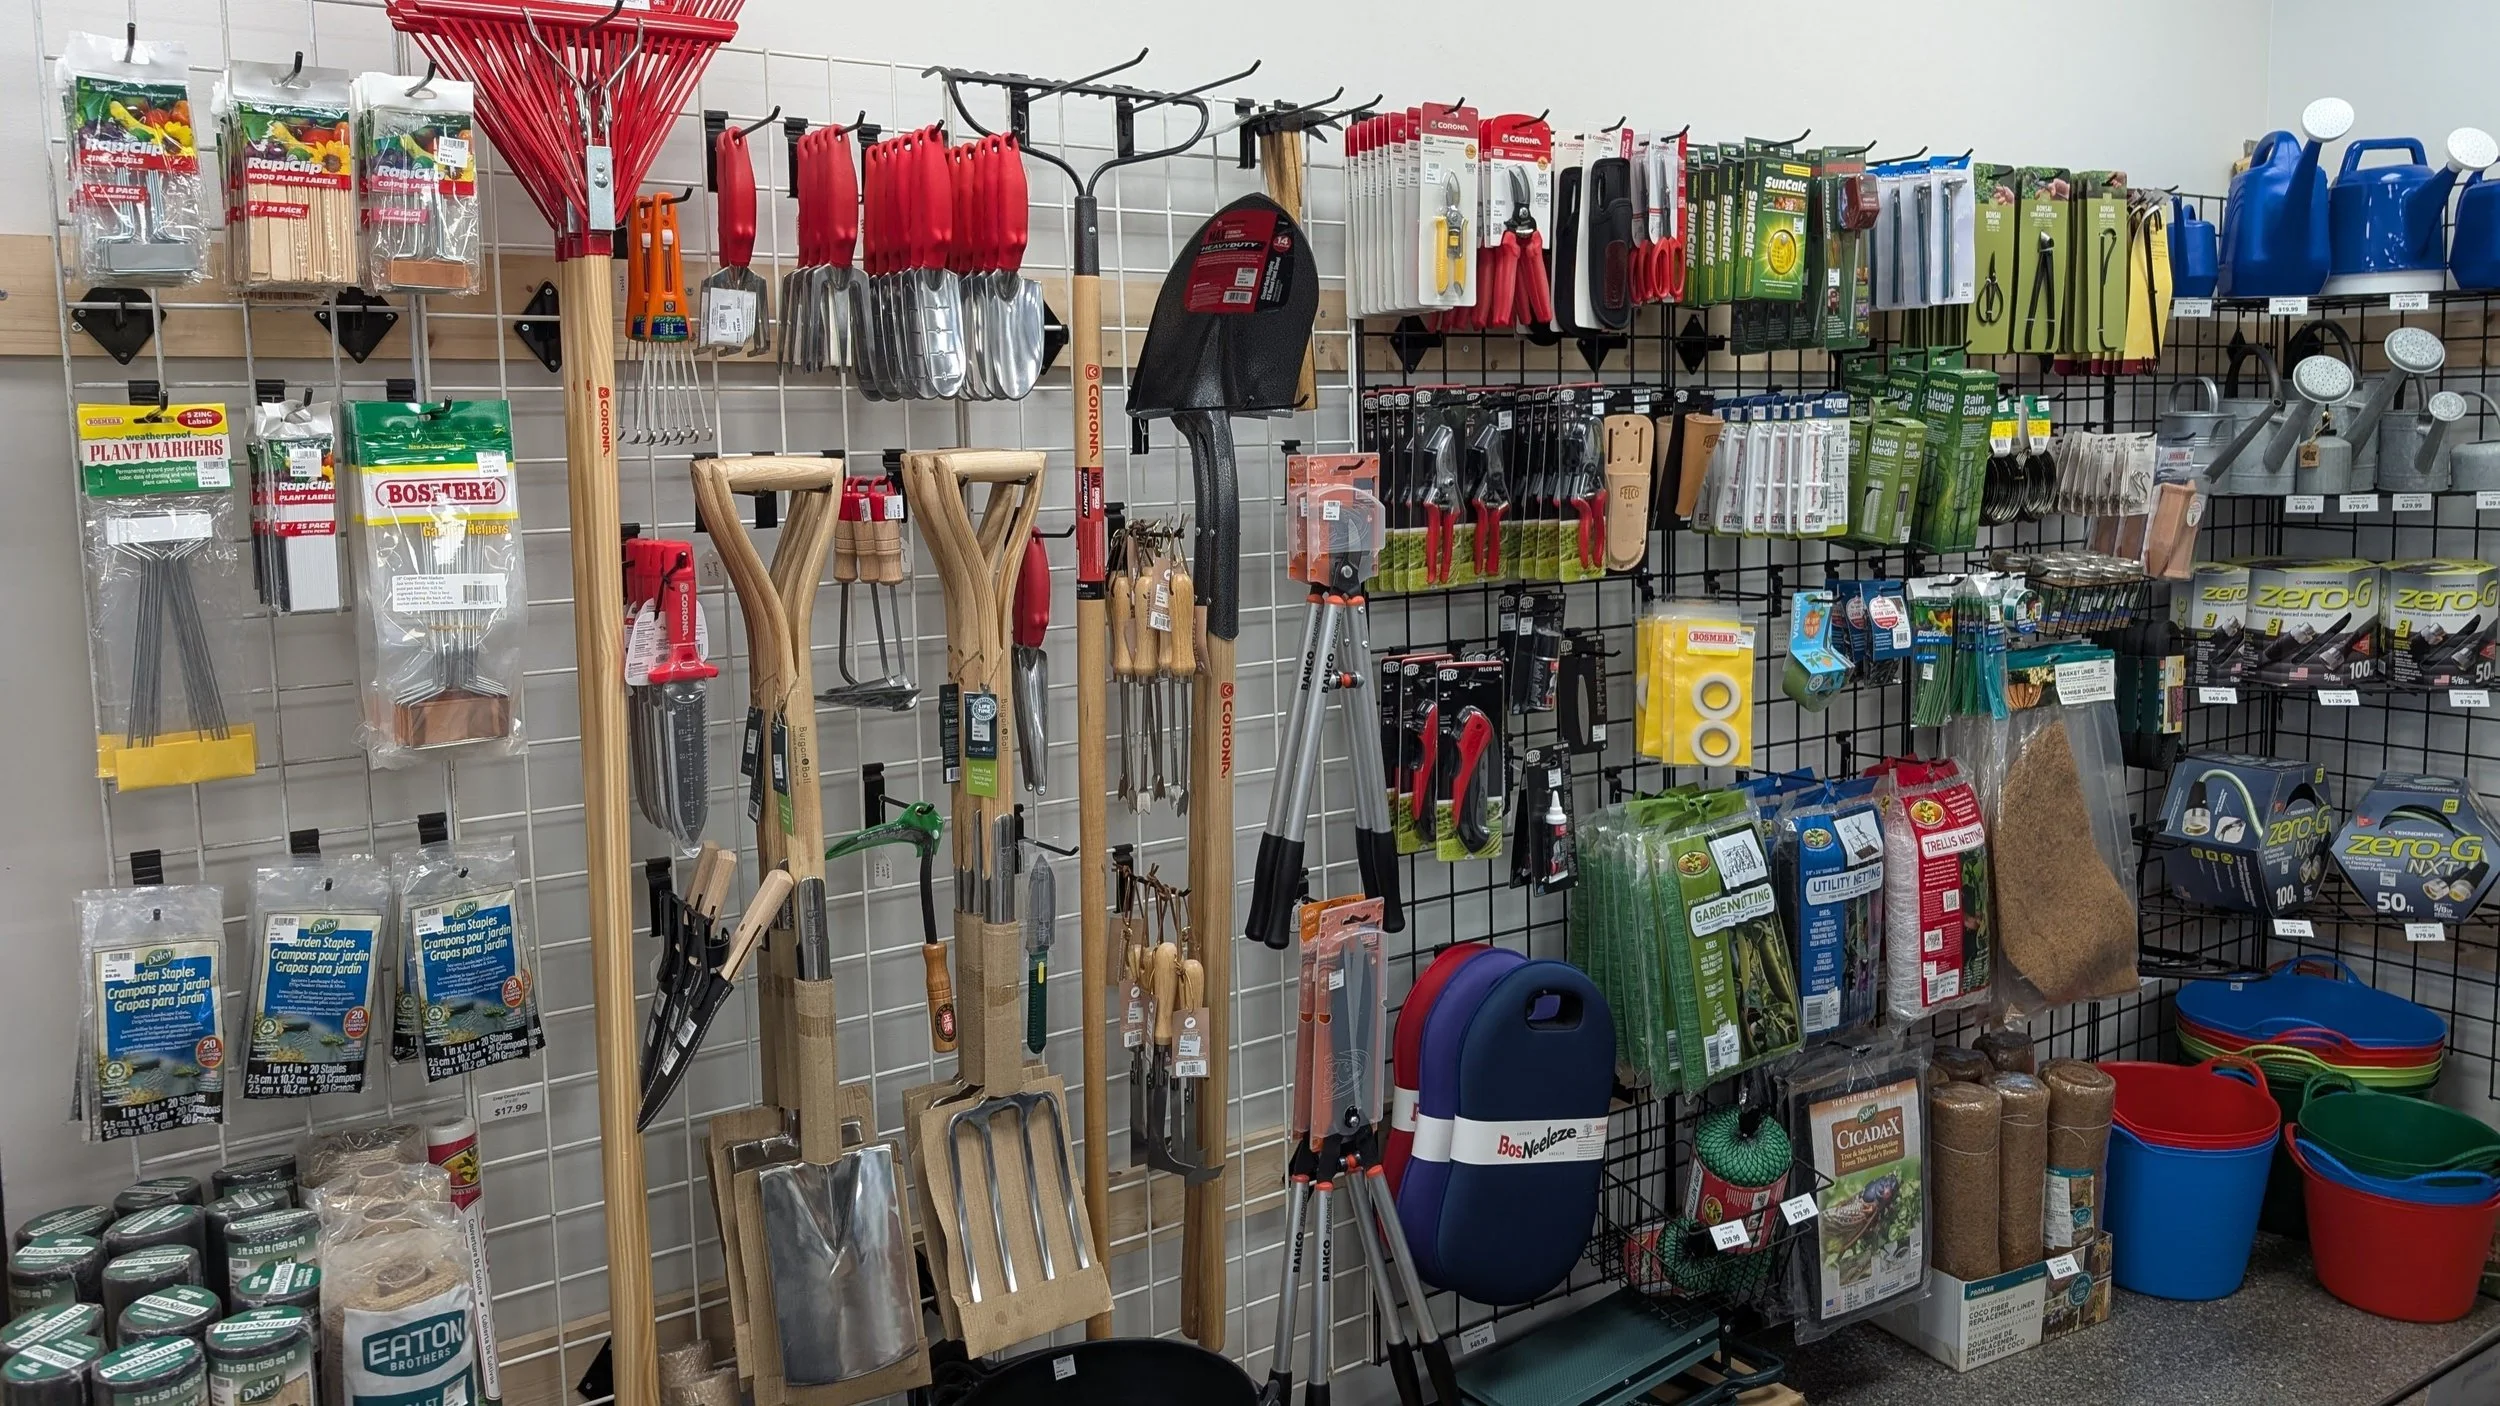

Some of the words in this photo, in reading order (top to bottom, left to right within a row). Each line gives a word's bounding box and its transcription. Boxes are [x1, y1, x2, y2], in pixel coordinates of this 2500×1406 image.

[1438, 121, 1469, 132] CORONA
[85, 138, 163, 157] RapiClip
[1509, 135, 1541, 146] CORONA
[111, 155, 144, 165] LABELS
[247, 158, 323, 175] RapiClip
[249, 172, 271, 181] WOOD
[276, 175, 303, 183] PLANT
[305, 176, 338, 186] LABELS
[377, 166, 445, 181] RapiClip
[115, 187, 141, 196] PACK
[378, 181, 407, 189] COPPER
[1764, 176, 1807, 193] SunCalc
[279, 206, 303, 216] PACK
[1722, 194, 1733, 262] SunCalc
[1745, 190, 1758, 260] SunCalc
[1276, 236, 1289, 245] 14
[1686, 202, 1697, 269] SunCalc
[1706, 200, 1716, 267] SunCalc
[1201, 242, 1258, 252] HEAVYDUTY
[2184, 308, 2201, 316] $9.99
[1889, 378, 1917, 390] rapitest
[1929, 379, 1959, 391] rapitest
[1965, 381, 1995, 392] rapitest
[1379, 394, 1394, 405] FELCO
[1394, 393, 1410, 405] FELCO
[1416, 391, 1432, 403] FELCO
[1560, 390, 1575, 401] FELCO
[1928, 388, 1955, 404] Lluvia
[1963, 394, 1985, 405] Rain
[1824, 398, 1849, 409] EZVIEW
[1926, 400, 1953, 414] Medir
[1962, 405, 1992, 416] Gauge
[600, 399, 610, 458] CORONA
[1088, 384, 1099, 460] CORONA
[126, 431, 192, 441] weatherproof
[1872, 437, 1898, 449] Lluvia
[90, 443, 142, 463] PLANT
[147, 439, 223, 460] MARKERS
[1871, 446, 1897, 457] Medir
[1905, 441, 1918, 450] Rain
[1903, 450, 1921, 460] Gauge
[278, 480, 335, 492] RapiClip
[387, 481, 496, 504] BOSMERE
[1620, 486, 1640, 499] FELCO
[1804, 515, 1823, 524] EZVIEW
[467, 524, 509, 536] Helpers
[1499, 595, 1515, 608] FELCO
[2255, 577, 2373, 611] zero-G
[2394, 579, 2498, 612] zero-G
[1520, 596, 1534, 609] FELCO
[681, 593, 689, 637] CORONA
[1792, 596, 1802, 639] VELCRO
[2269, 618, 2277, 628] 5
[2399, 620, 2407, 630] 5
[1693, 633, 1734, 643] BOSMERE
[1301, 650, 1314, 692] BAHCO
[1322, 653, 1335, 695] BAHCO
[1383, 661, 1400, 674] FELCO
[1404, 663, 1420, 676] FELCO
[1440, 669, 1459, 681] FELCO
[2349, 659, 2370, 680] 100
[2475, 661, 2492, 683] 50
[1221, 700, 1232, 776] CORONA
[1526, 750, 1541, 763] FELCO
[2266, 804, 2331, 848] zero-G
[1925, 836, 1958, 853] TRELLIS
[1958, 828, 1984, 845] NETTING
[2394, 830, 2421, 838] TEKNOR
[2294, 833, 2318, 860] NXT
[2345, 833, 2484, 863] zero-G
[2407, 859, 2460, 878] NXT
[1813, 877, 1850, 893] UTILITY
[1853, 865, 1881, 884] NETTING
[2275, 885, 2294, 907] 100
[2377, 891, 2406, 912] 50
[467, 915, 498, 931] Staples
[423, 936, 465, 951] Crampons
[466, 931, 485, 946] pour
[486, 924, 512, 941] jardin
[2281, 928, 2306, 936] $129.99
[322, 936, 356, 949] Staples
[271, 948, 317, 962] Crampons
[318, 950, 339, 963] pour
[340, 949, 370, 964] jardin
[430, 948, 461, 962] Grapas
[462, 944, 482, 957] para
[162, 966, 196, 981] Staples
[275, 961, 309, 975] Grapas
[309, 963, 333, 976] para
[107, 983, 157, 1001] Crampons
[158, 982, 180, 995] pour
[181, 977, 211, 991] jardin
[507, 980, 518, 989] 20
[114, 996, 150, 1013] Grapas
[151, 994, 175, 1008] para
[351, 1010, 364, 1020] 20
[202, 1040, 217, 1050] 20
[481, 1037, 490, 1047] 20
[489, 1031, 513, 1046] Staples
[439, 1055, 450, 1066] cm
[457, 1051, 471, 1063] 10.2
[471, 1050, 482, 1060] cm
[496, 1038, 528, 1053] Crampons
[309, 1064, 320, 1074] 20
[321, 1063, 347, 1075] Staples
[247, 1073, 261, 1084] 2.5
[262, 1076, 273, 1084] cm
[280, 1074, 295, 1085] 10.2
[296, 1076, 308, 1085] cm
[315, 1075, 326, 1085] 20
[326, 1073, 362, 1085] Crampons
[167, 1098, 179, 1110] 20
[179, 1092, 206, 1108] Staples
[116, 1118, 130, 1129] cm
[155, 1111, 168, 1123] cm
[188, 1103, 222, 1117] Crampons
[494, 1102, 528, 1117] $17.99
[1836, 1116, 1901, 1150] CICADA-X
[1497, 1126, 1577, 1160] BosNeeleze
[1873, 1140, 1899, 1152] Protection
[1793, 1207, 1810, 1219] $79.99
[1722, 1234, 1741, 1245] $39.99
[1292, 1231, 1304, 1273] BAHCO
[1322, 1239, 1331, 1282] BAHCO
[468, 1218, 479, 1258] Couverture
[475, 1269, 483, 1296] Culture
[481, 1314, 490, 1344] Cubierta
[1968, 1309, 1989, 1319] COCO
[1990, 1302, 2010, 1313] FIBER
[1968, 1306, 2016, 1327] REPLACEMENT
[2016, 1300, 2036, 1311] LINER
[369, 1318, 462, 1367] EATON
[1470, 1336, 1489, 1349] $49.99
[1967, 1332, 2002, 1349] DOUBLURE
[1967, 1334, 2018, 1356] REMPLACEMENT
[2007, 1338, 2026, 1350] COCO
[254, 1357, 275, 1371] (150
[390, 1347, 451, 1371] BROTHERS
[243, 1375, 281, 1401] Dalen
